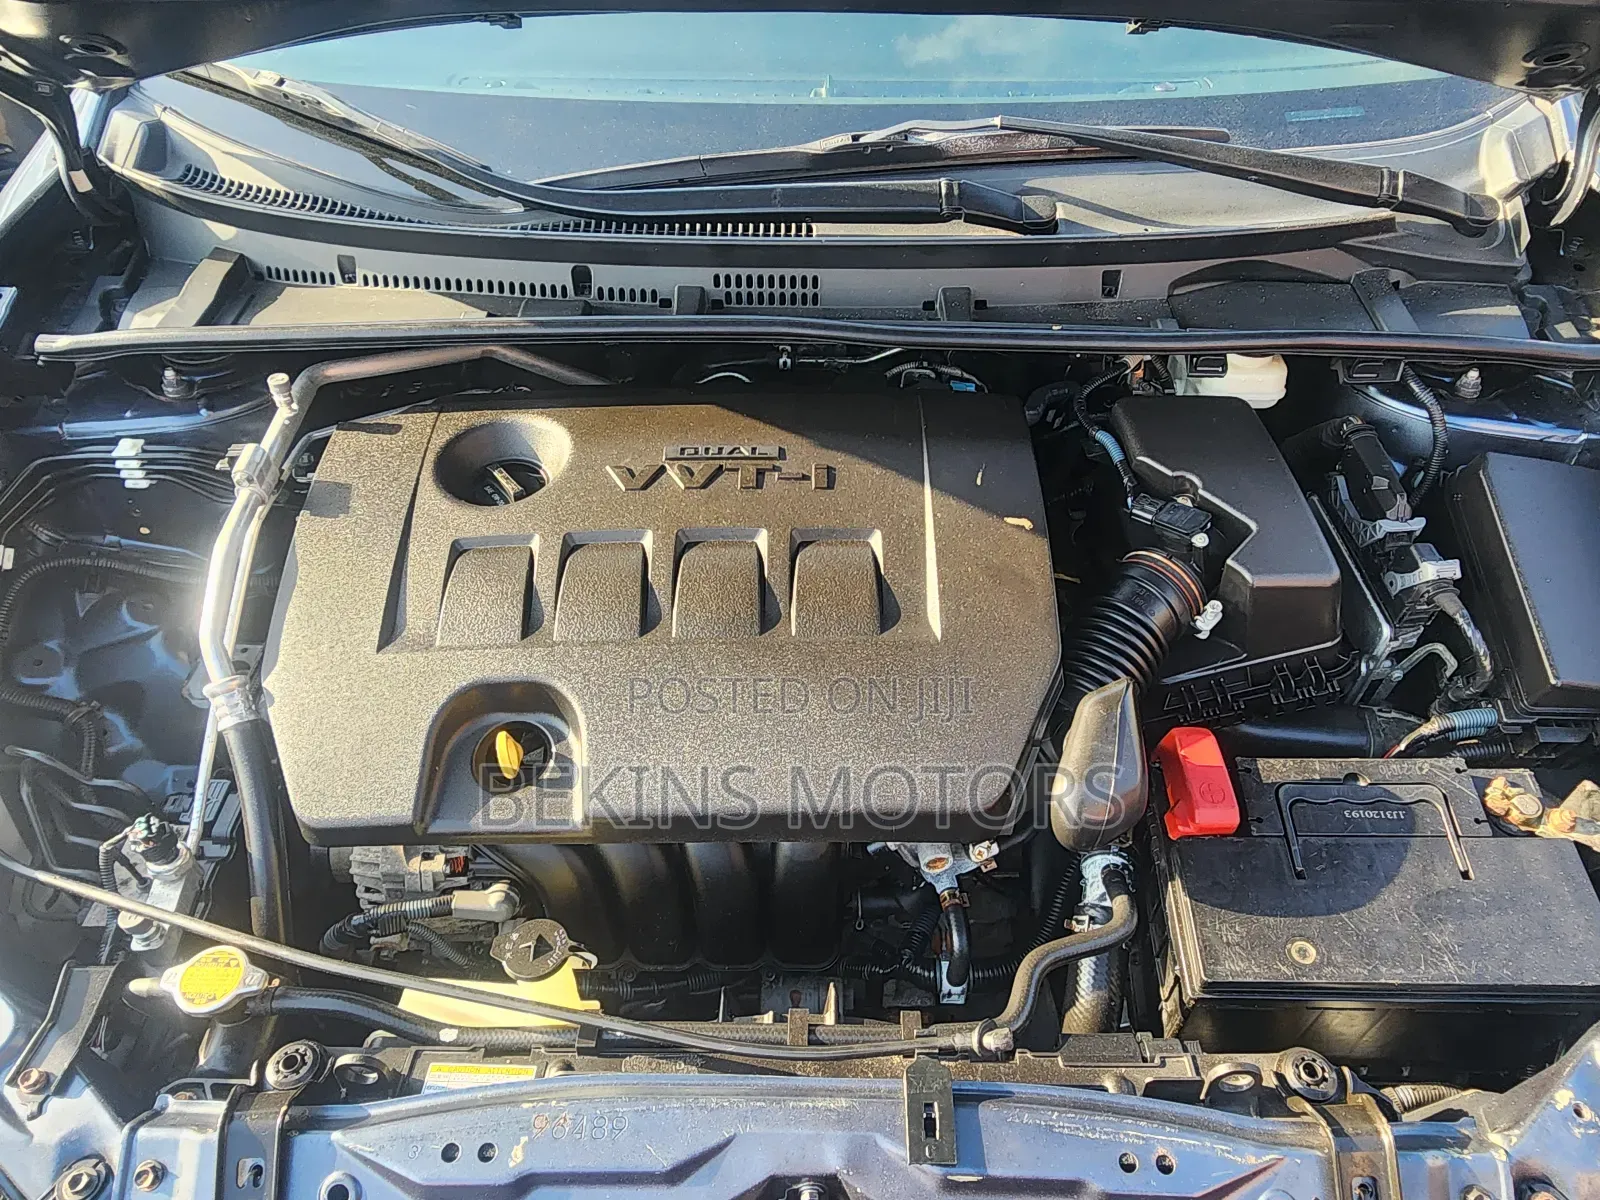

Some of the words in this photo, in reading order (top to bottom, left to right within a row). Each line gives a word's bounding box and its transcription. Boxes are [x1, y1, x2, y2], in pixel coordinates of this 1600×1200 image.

[679, 445, 771, 457] DUAL
[447, 1066, 481, 1074] CAUTION
[487, 1067, 529, 1075] ATTENTION
[532, 1113, 629, 1140] 96489
